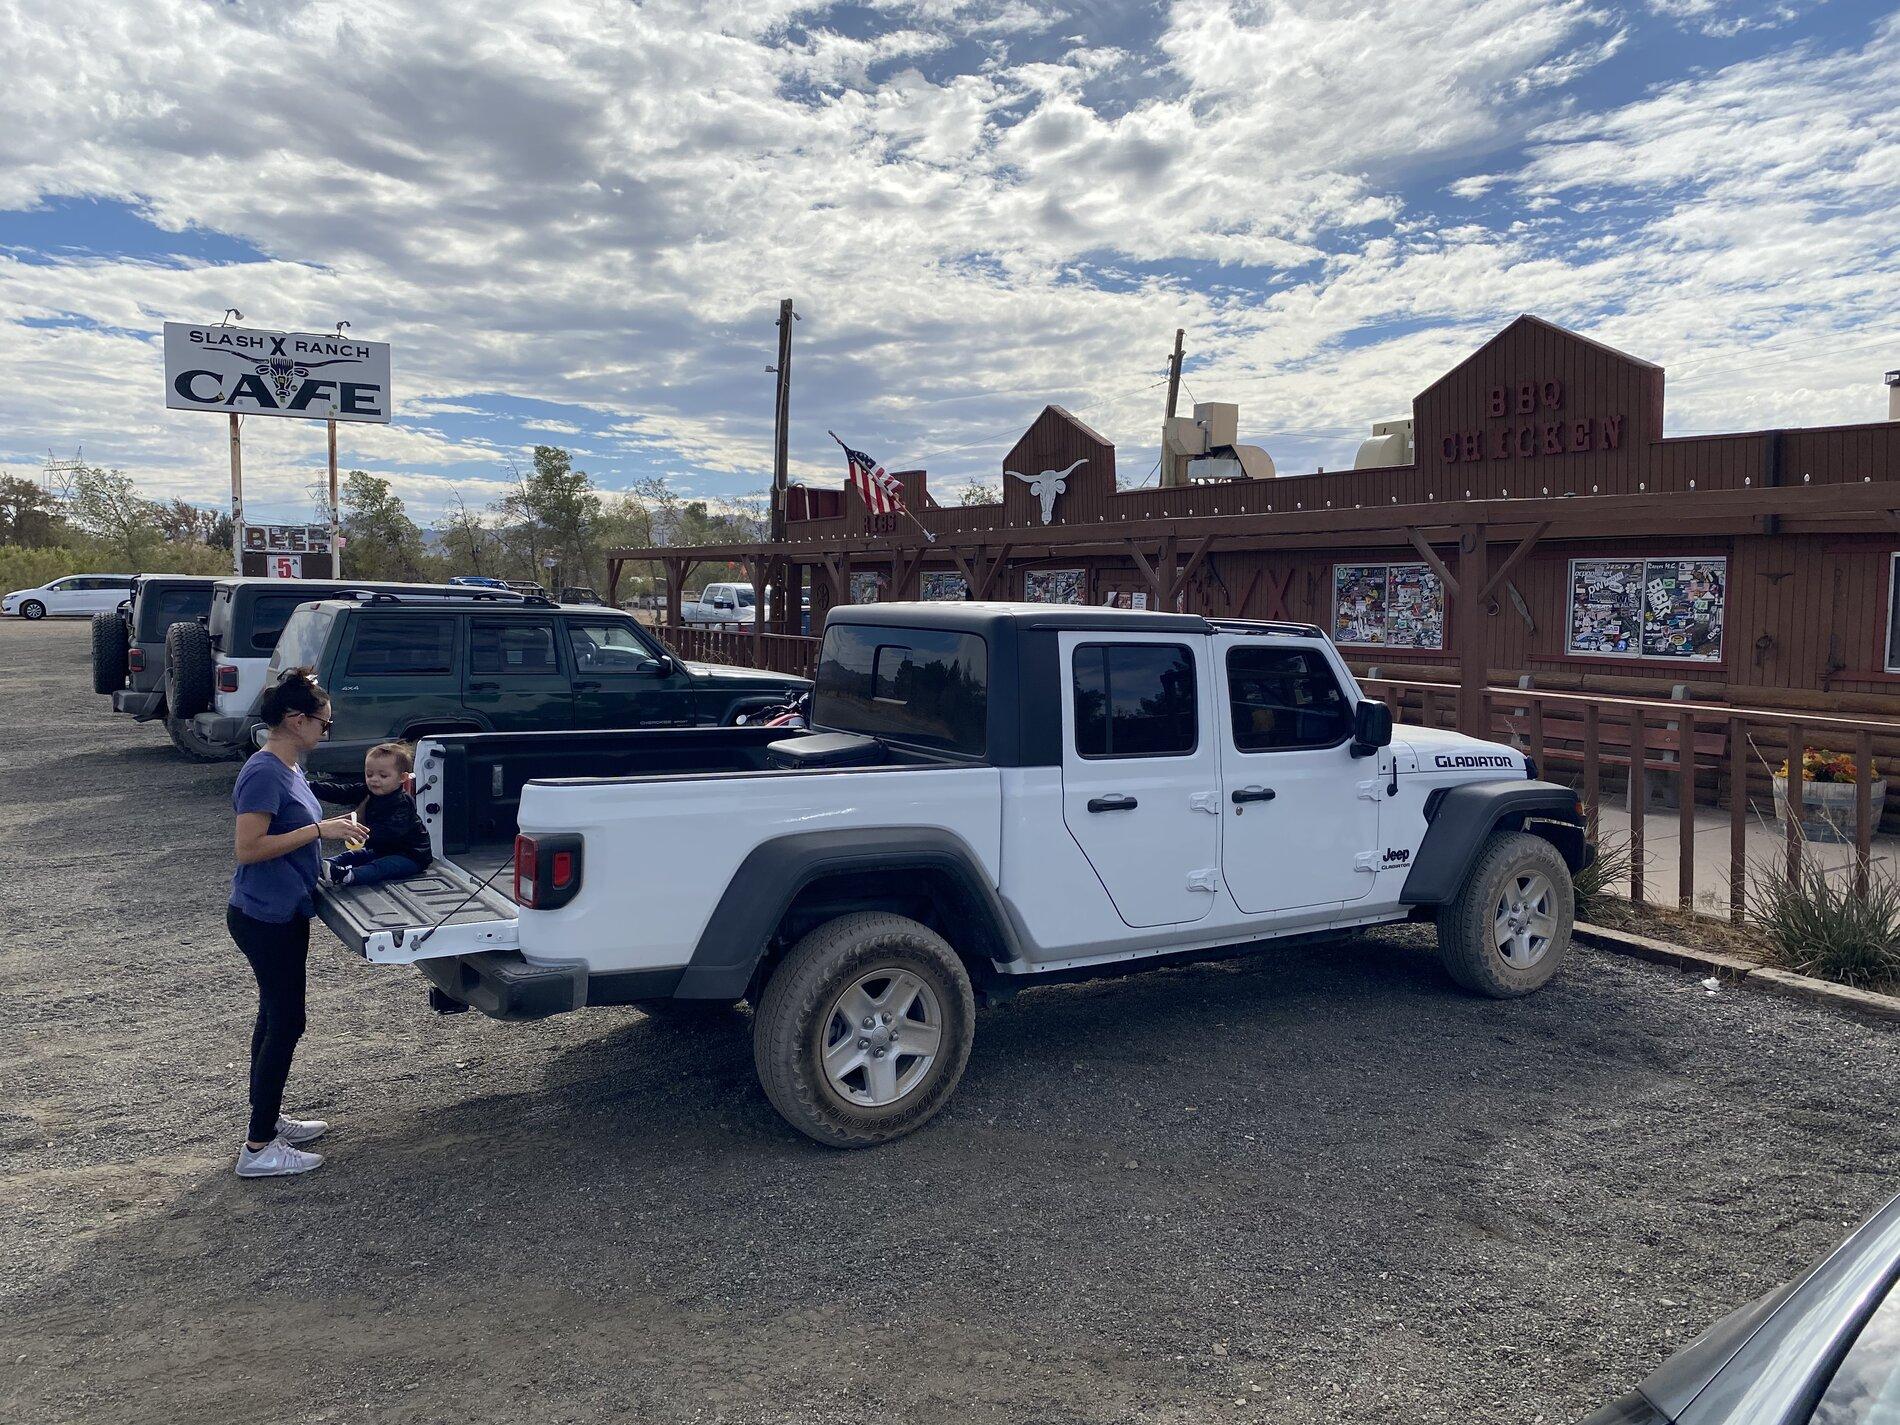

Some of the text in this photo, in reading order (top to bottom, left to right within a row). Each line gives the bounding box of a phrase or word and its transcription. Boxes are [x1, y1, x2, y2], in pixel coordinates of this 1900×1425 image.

[189, 331, 370, 359] SLASH X RANCH
[174, 369, 382, 416] CAFE
[1488, 377, 1563, 418] BBQ
[1441, 415, 1623, 463] CHICKEN
[863, 514, 897, 532] RIBS
[245, 527, 329, 553] BEER
[277, 558, 292, 578] 5
[1434, 755, 1513, 768] GLADIATOR
[1381, 862, 1411, 870] GLADIATOR
[1382, 848, 1410, 862] Jeep
